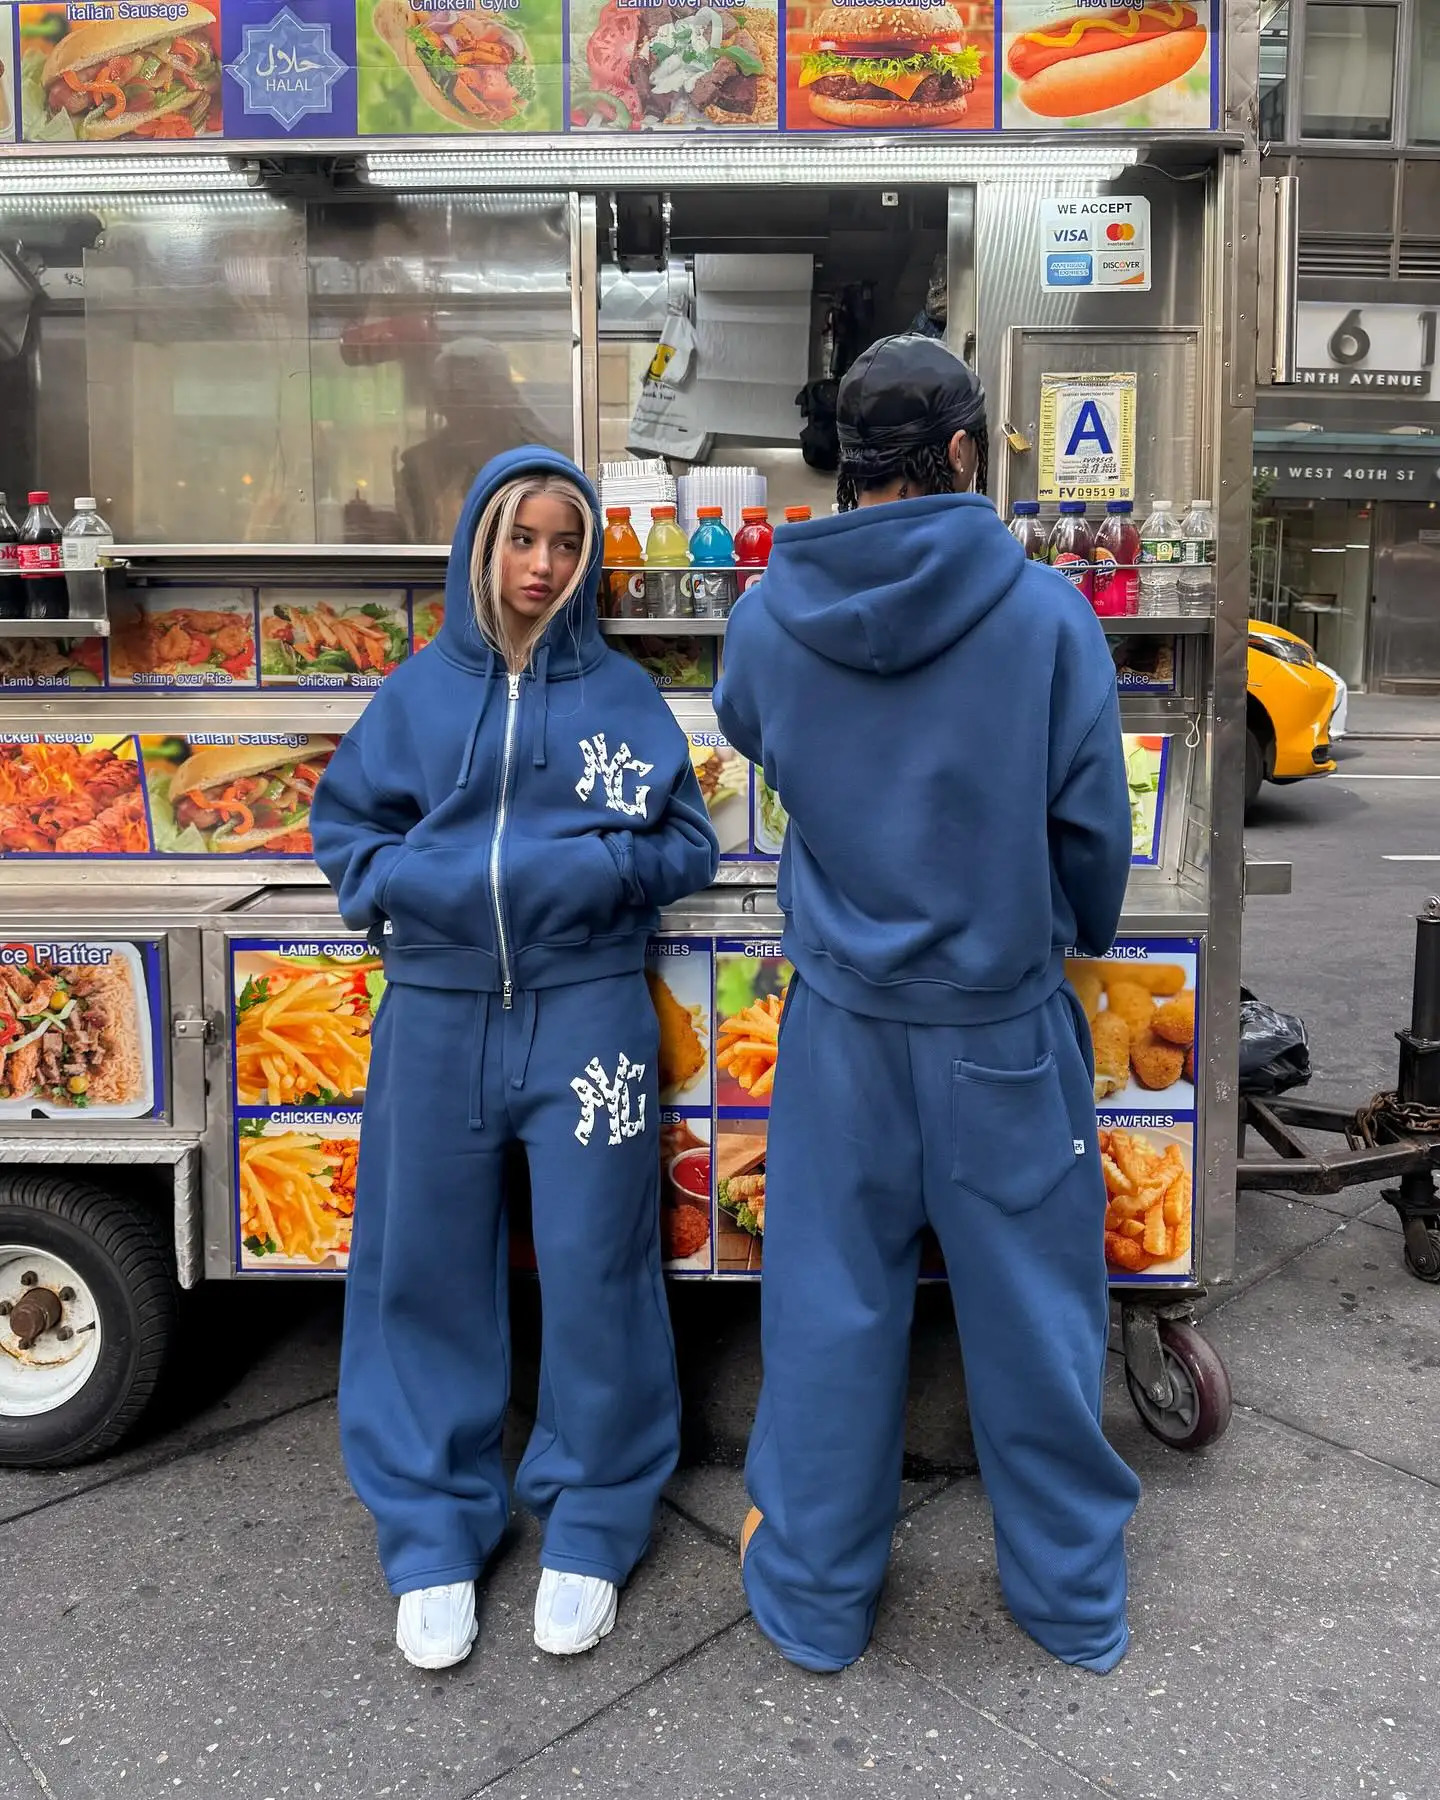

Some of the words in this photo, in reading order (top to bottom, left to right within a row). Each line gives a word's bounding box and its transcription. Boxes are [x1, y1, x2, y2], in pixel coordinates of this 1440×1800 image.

[66, 4, 113, 20] Italian
[119, 4, 188, 20] Sausage
[266, 79, 312, 92] HALAL
[1057, 204, 1077, 214] WE
[1081, 203, 1132, 214] ACCEPT
[1053, 229, 1089, 242] VISA
[1350, 374, 1423, 386] AVENUE
[1065, 400, 1113, 455] A
[1289, 467, 1333, 479] WEST
[1344, 468, 1387, 480] 40TH
[1397, 470, 1415, 481] ST
[3, 676, 34, 687] Lamb
[37, 675, 70, 686] Salad
[133, 673, 174, 686] Shrimp
[176, 675, 202, 684] over
[206, 673, 232, 684] Rice
[298, 676, 344, 687] Chicken
[650, 675, 672, 687] yro
[1123, 673, 1149, 684] Rice
[187, 734, 234, 745] Italian
[240, 734, 308, 747] Sausage
[692, 734, 731, 746] Stea
[36, 945, 111, 964] Platter
[280, 945, 319, 955] LAMB
[323, 945, 364, 956] GYRO
[744, 946, 784, 957] CHEE
[271, 1112, 332, 1123] CHICKEN
[1115, 1115, 1174, 1127] W/FRIES
